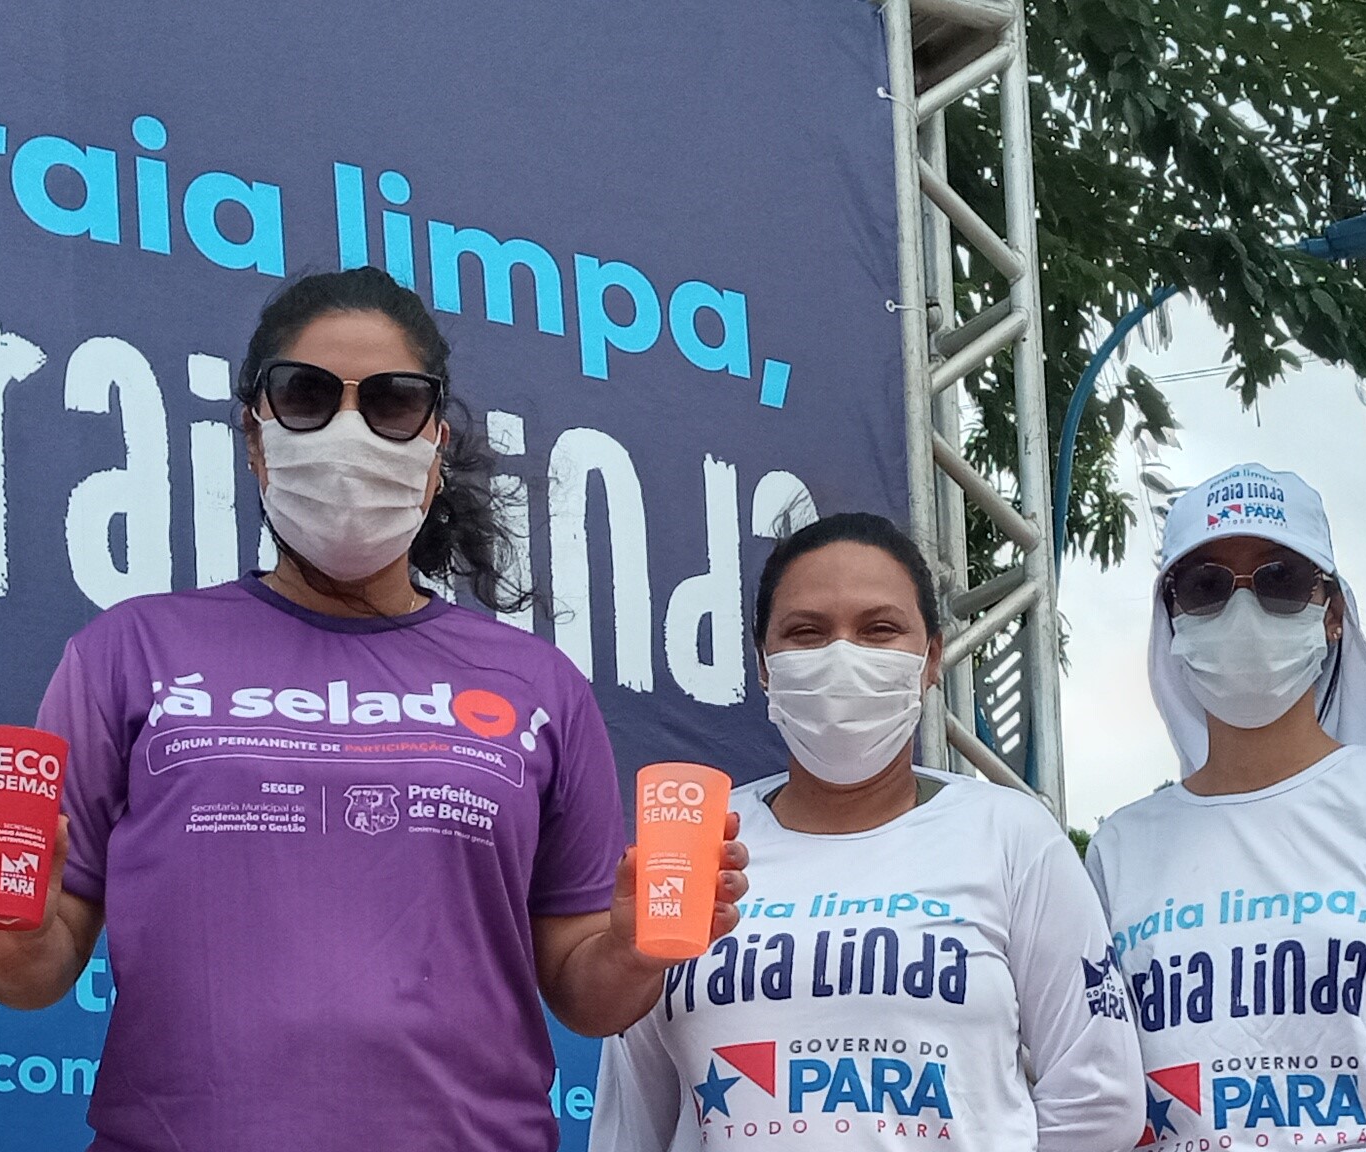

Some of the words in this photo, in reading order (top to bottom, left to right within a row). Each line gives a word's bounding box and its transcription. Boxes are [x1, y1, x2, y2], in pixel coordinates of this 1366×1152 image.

[334, 161, 793, 410] limpa,
[165, 737, 213, 755] FÓRUM
[218, 736, 318, 751] PERMANENTE
[321, 742, 341, 752] DE
[261, 782, 305, 794] SEGEP
[643, 780, 705, 807] ECO
[242, 803, 289, 813] Municipal
[408, 784, 499, 816] Prefeitura
[190, 812, 259, 823] Coordenação
[261, 813, 289, 822] Geral
[291, 813, 306, 823] do
[408, 801, 435, 818] de
[643, 806, 703, 824] SEMAS
[185, 822, 258, 833] Planejamento
[268, 823, 306, 833] Gestão
[1131, 951, 1214, 1032] raia
[789, 1038, 907, 1054] GOVERNO
[919, 1041, 949, 1059] DO
[1211, 1055, 1318, 1073] GOVERNO
[1330, 1055, 1359, 1069] DO
[724, 1119, 808, 1139] TODO
[835, 1118, 850, 1133] O
[877, 1119, 951, 1140] PARÁ
[1255, 1134, 1269, 1148] O
